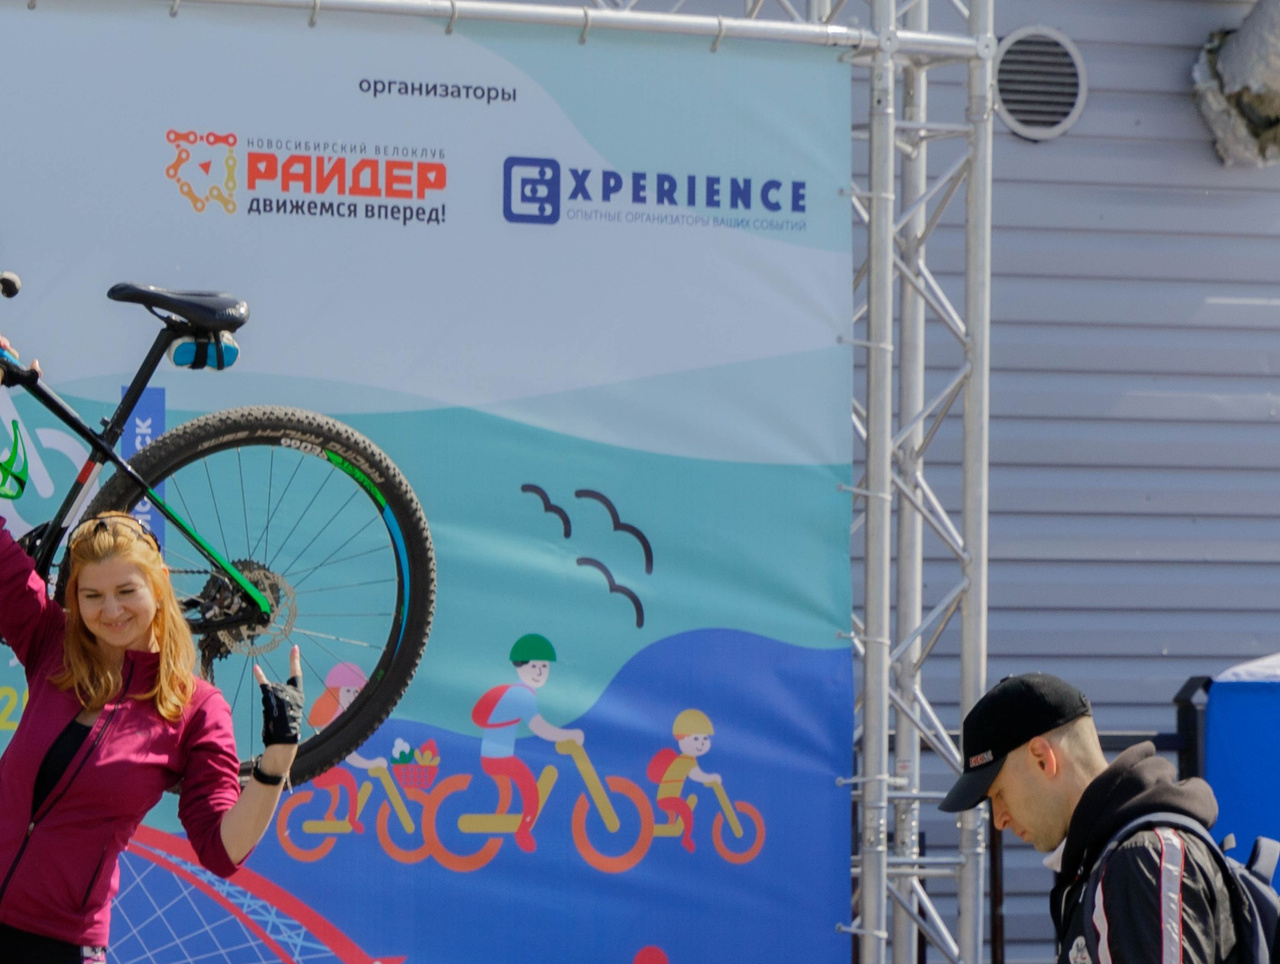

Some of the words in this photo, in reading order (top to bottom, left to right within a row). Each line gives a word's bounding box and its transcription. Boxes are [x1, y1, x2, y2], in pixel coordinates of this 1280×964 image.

[359, 79, 517, 105] организаторы
[247, 137, 367, 155] НОВОСИБИРСКИЙ
[374, 145, 446, 160] ВЕЛОКЛУБ
[247, 152, 447, 200] РАЙДЕР
[247, 197, 358, 219] движемся
[365, 203, 447, 226] вперед!
[567, 208, 623, 223] ОПЫТНЫЕ
[625, 211, 710, 228] ОРГАНИЗАТОРЫ
